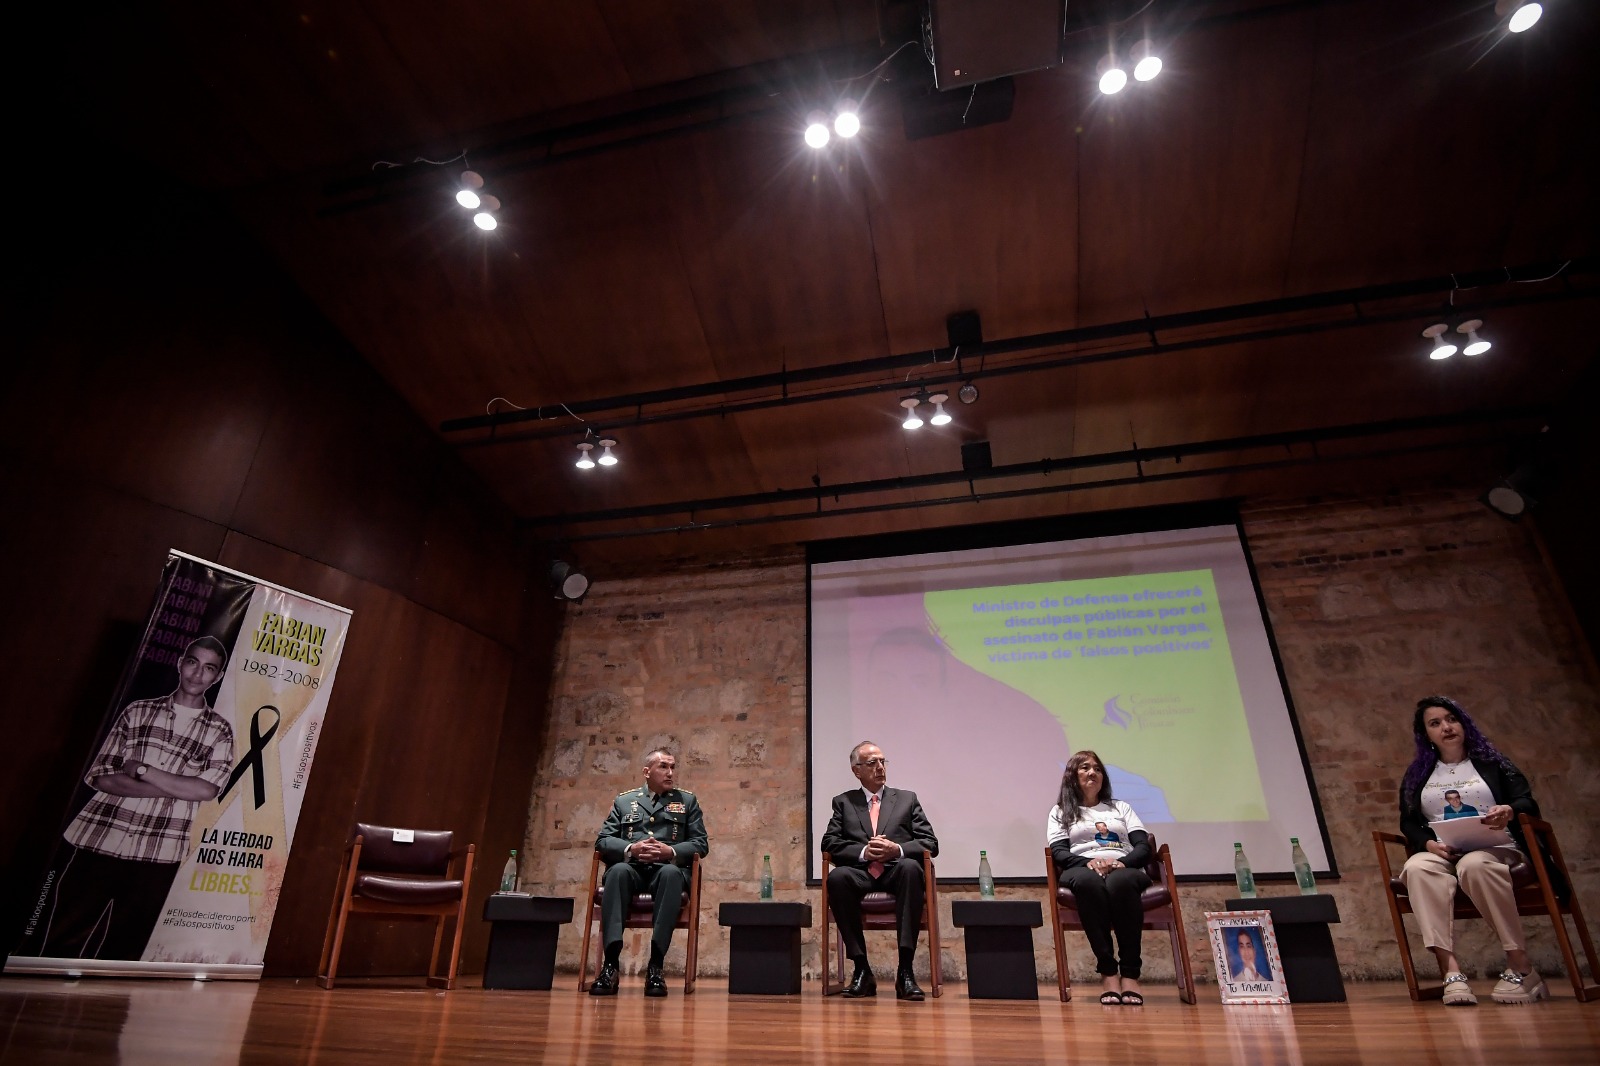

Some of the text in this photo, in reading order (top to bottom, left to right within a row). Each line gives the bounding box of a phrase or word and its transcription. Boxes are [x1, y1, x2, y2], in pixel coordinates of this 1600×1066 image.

[972, 585, 1203, 614] Ministro de Defensa ofrecerá
[260, 611, 326, 646] FABIAN
[1005, 602, 1206, 629] disculpas públicas por el
[252, 629, 322, 666] VARGAS
[983, 631, 1059, 647] asesinato
[1063, 628, 1083, 642] de
[1086, 624, 1144, 640] Fabián
[140, 640, 178, 668] FABIA
[1052, 646, 1073, 659] de
[241, 658, 319, 690] 1982-2008
[292, 721, 317, 789] #Falsospositivos
[201, 827, 273, 850] LA VERDAD
[196, 847, 264, 869] NOS HARA
[188, 870, 263, 896] LIBRES...
[24, 870, 56, 936] #Falsospositivos
[163, 918, 235, 931] #Falsospositivos
